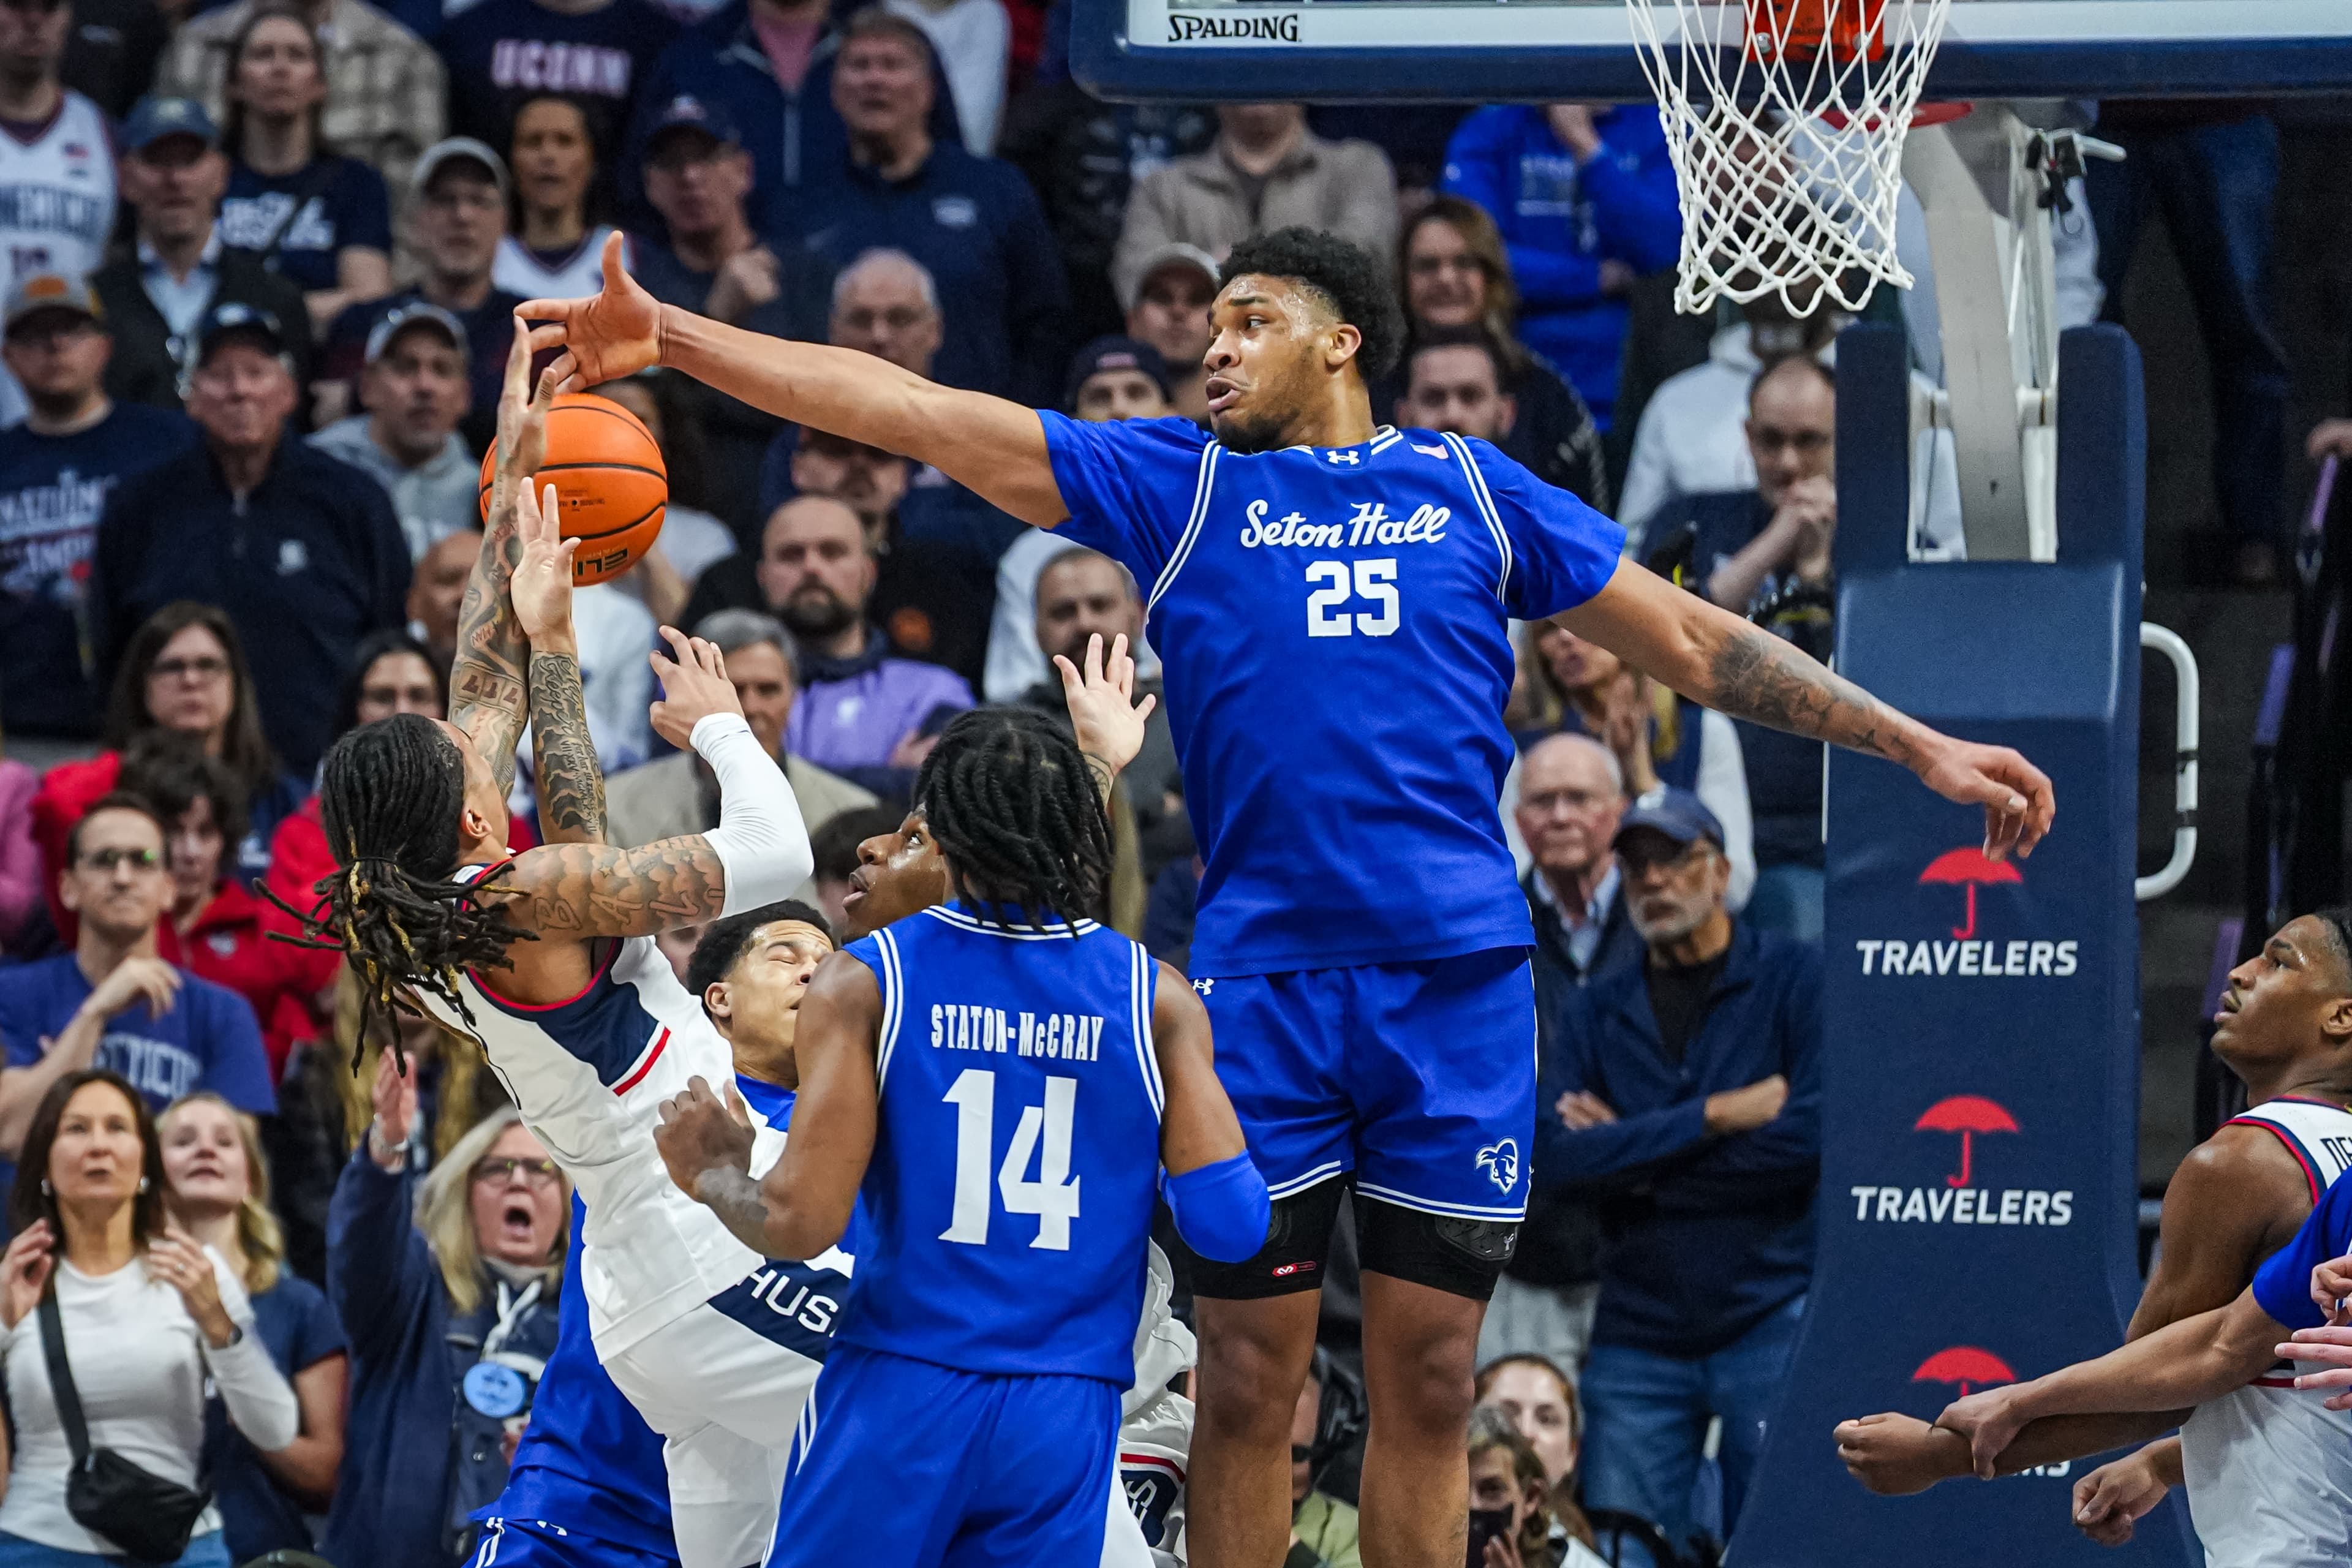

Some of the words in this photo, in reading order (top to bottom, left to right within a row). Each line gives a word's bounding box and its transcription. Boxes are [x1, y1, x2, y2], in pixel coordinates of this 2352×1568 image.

[1168, 13, 1298, 42] SPALDING
[1240, 499, 1343, 548] Seton
[1348, 503, 1451, 547] Hall
[1306, 558, 1400, 637] 25
[1856, 940, 2078, 976] TRAVELERS
[931, 1004, 1104, 1061] STATON-McCRAY
[938, 1068, 1080, 1251] 14
[1850, 1186, 2074, 1226] TRAVELERS
[736, 1268, 839, 1338] HUS
